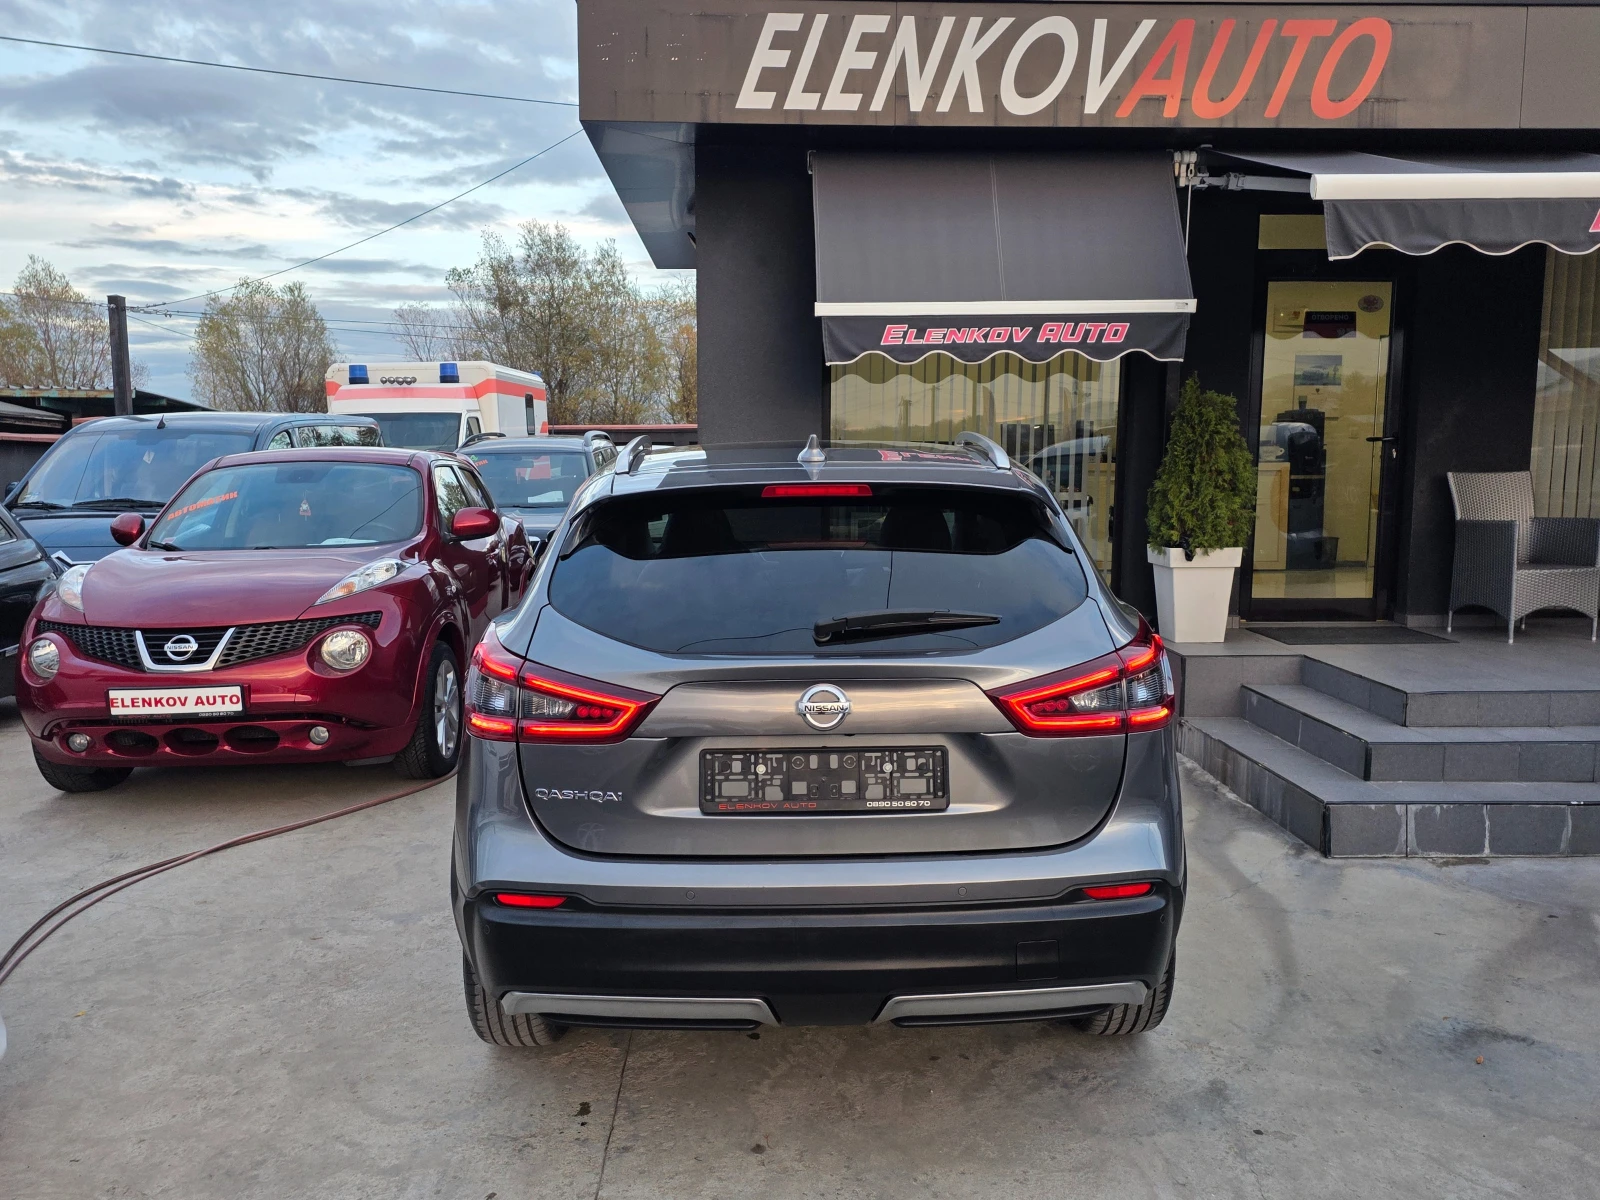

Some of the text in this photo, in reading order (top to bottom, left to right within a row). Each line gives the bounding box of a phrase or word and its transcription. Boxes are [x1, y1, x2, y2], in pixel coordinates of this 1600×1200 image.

[880, 322, 1131, 346] ELENKOV AUTO
[110, 694, 240, 708] ELENKOV AUTO
[804, 704, 845, 712] NISSAN
[535, 787, 623, 803] QASHQAI
[718, 802, 778, 810] ELENKOV
